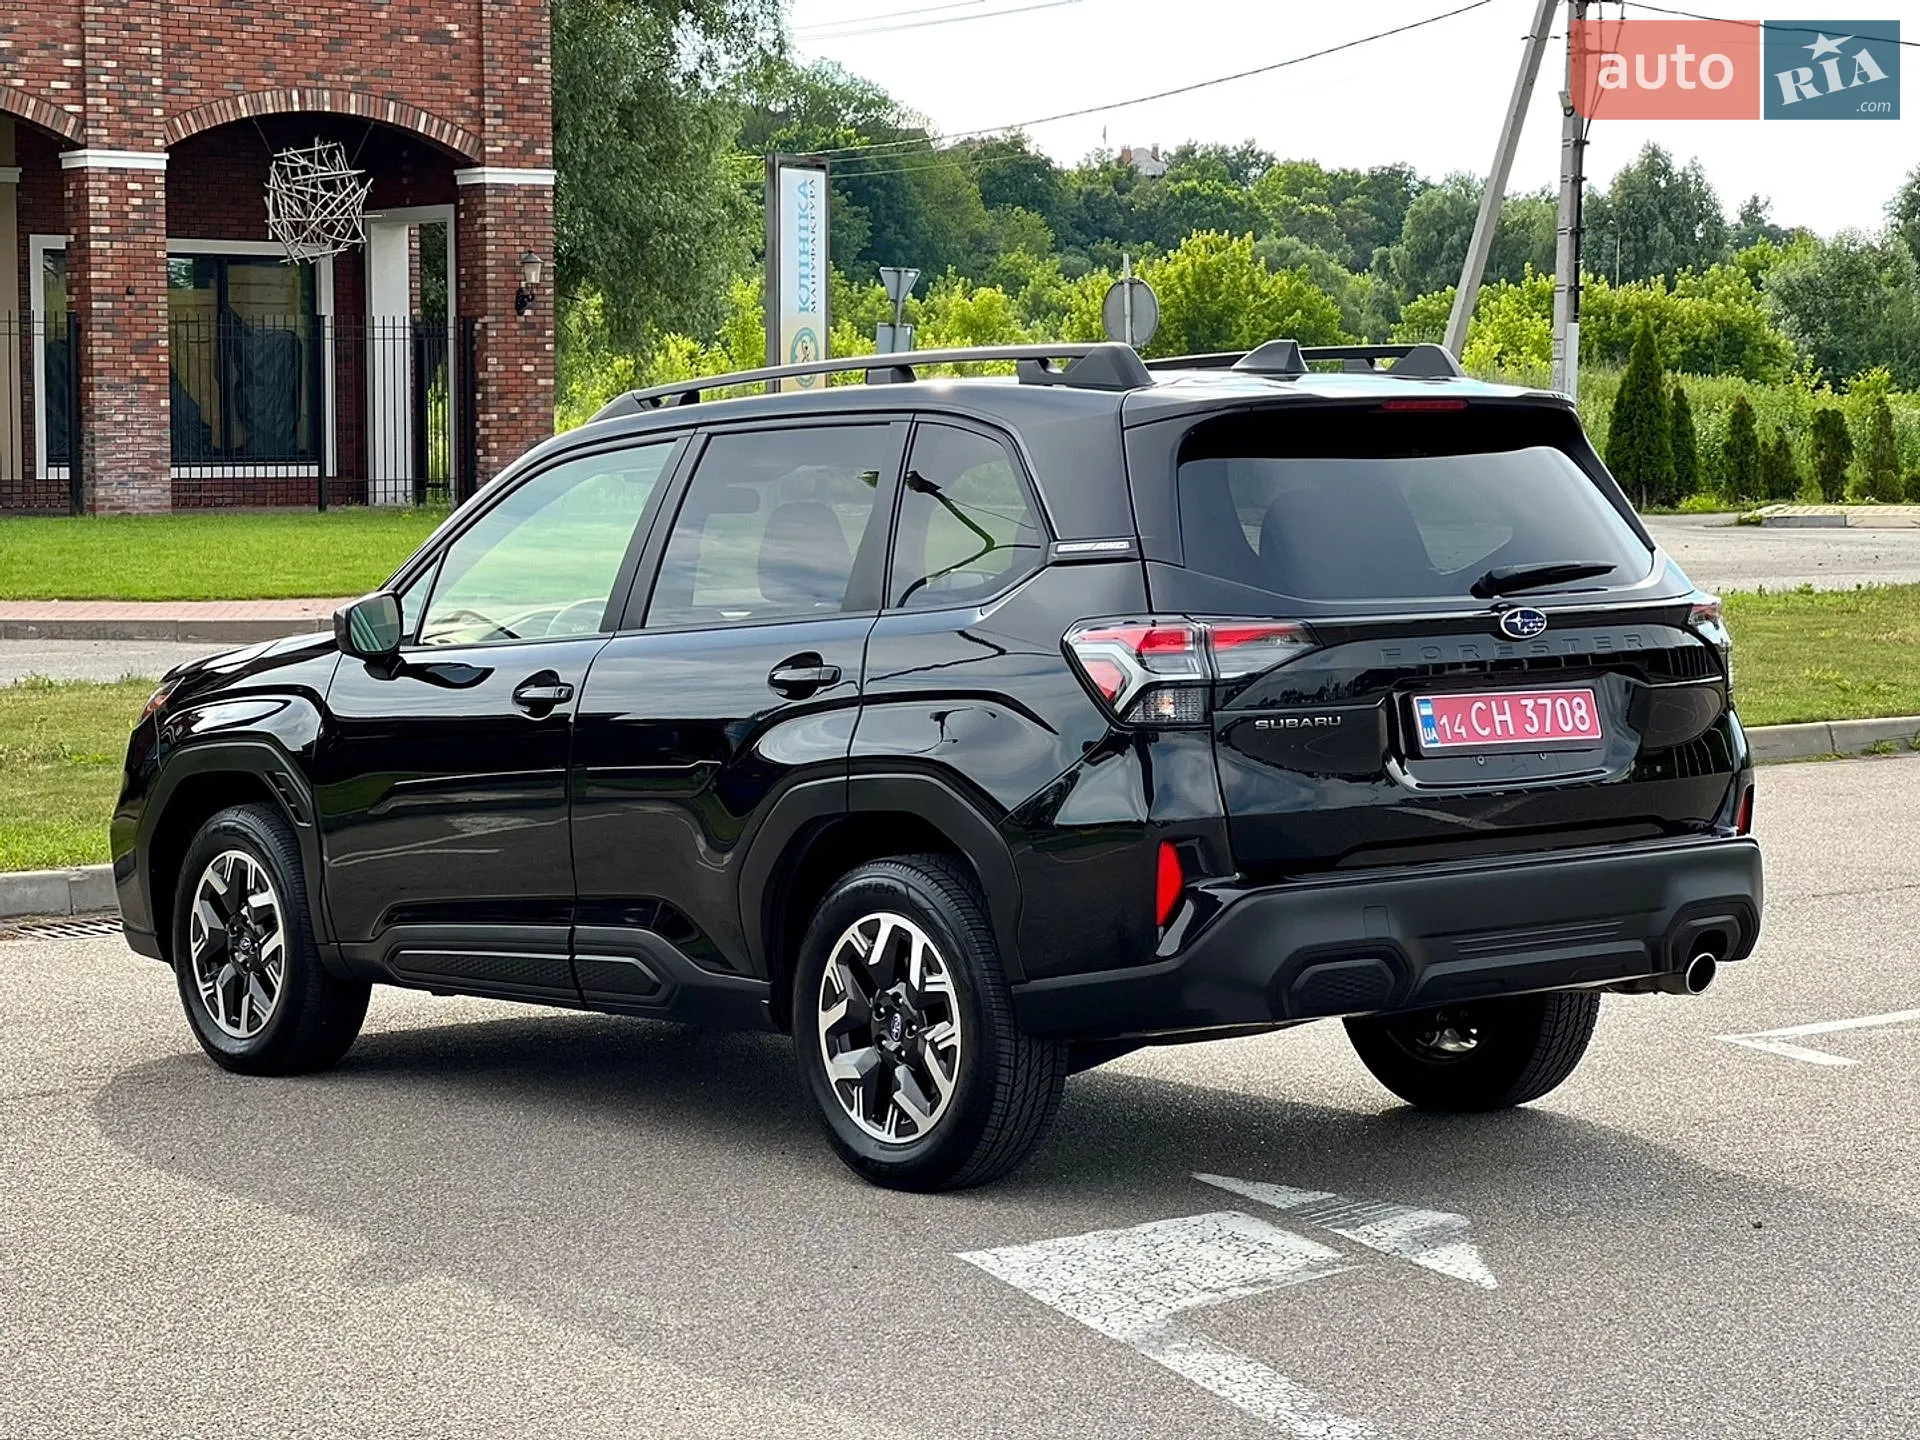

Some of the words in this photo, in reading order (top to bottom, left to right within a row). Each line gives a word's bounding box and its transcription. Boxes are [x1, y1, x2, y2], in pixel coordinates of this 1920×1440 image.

[797, 180, 809, 314] КЛІНІКА
[1380, 633, 1643, 664] FORESTER
[1254, 716, 1341, 730] SUBARU
[1439, 713, 1468, 740] 14
[1520, 696, 1591, 736] 3708
[1423, 727, 1439, 741] UA
